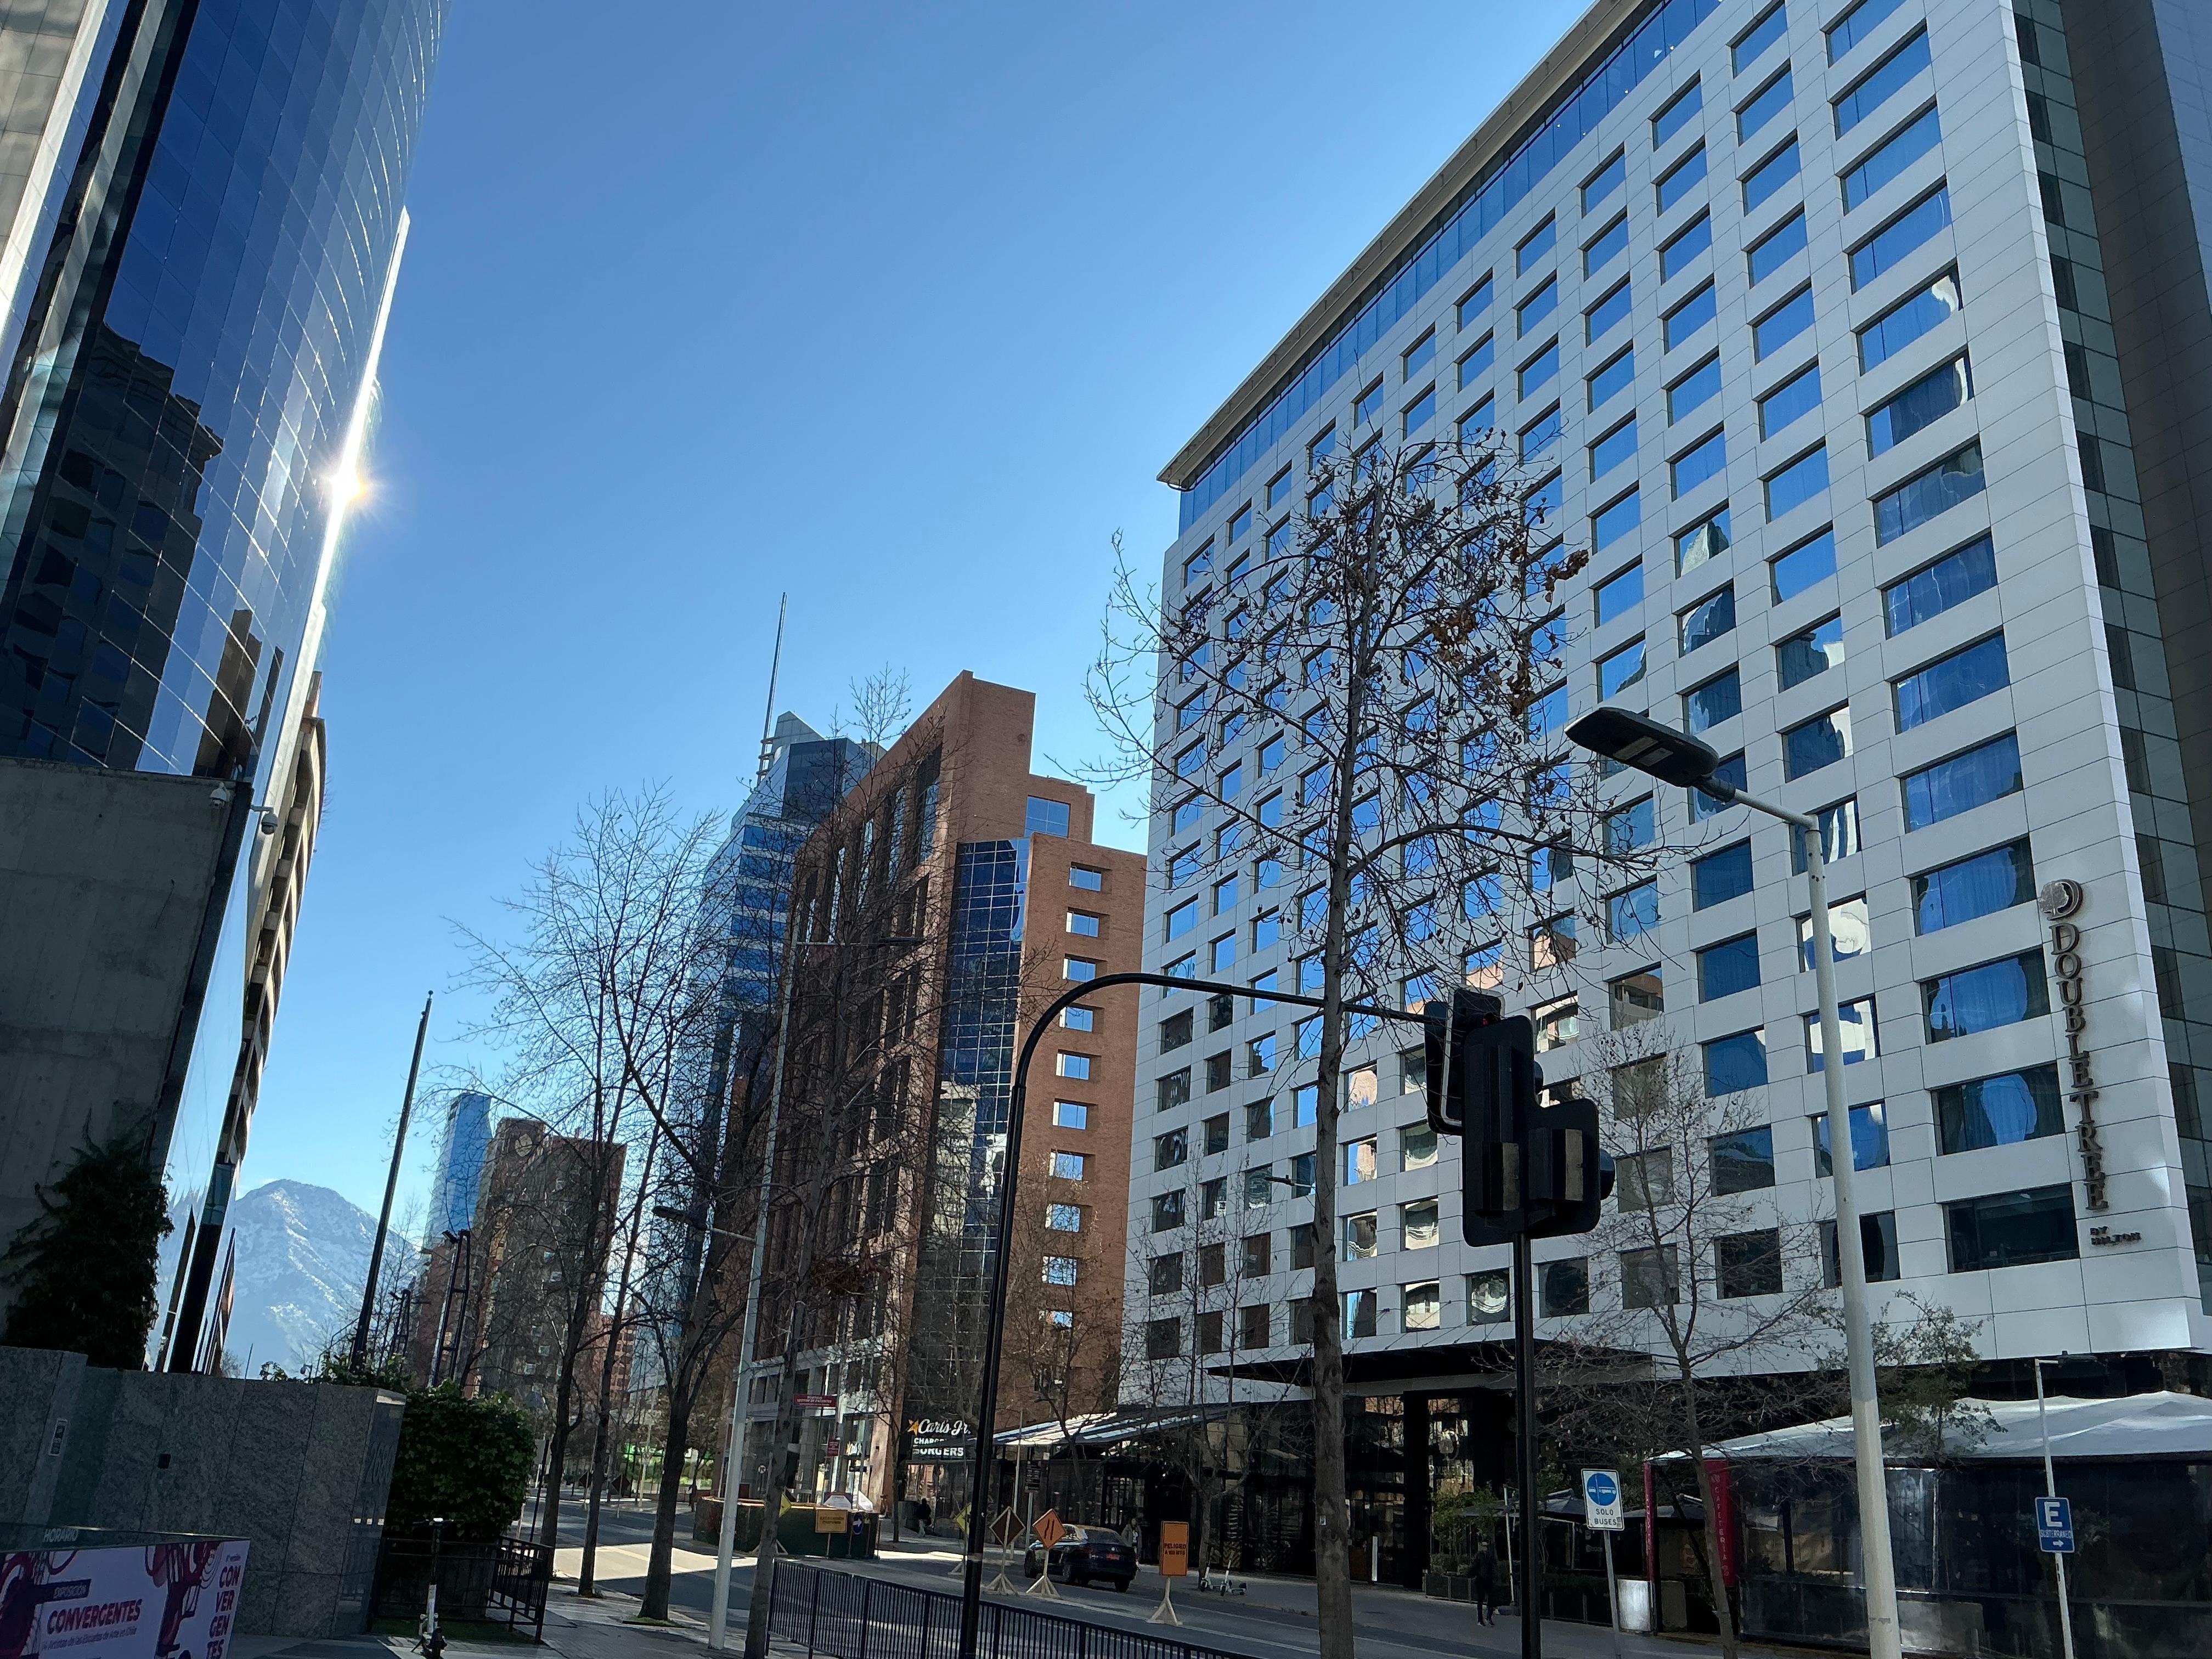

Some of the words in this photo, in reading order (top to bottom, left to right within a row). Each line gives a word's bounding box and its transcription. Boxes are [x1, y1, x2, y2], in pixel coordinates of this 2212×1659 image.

[2049, 922, 2108, 1211] DOUBLETREE
[918, 1419, 951, 1434] Carl's
[951, 1420, 971, 1436] Jr.
[2044, 1502, 2062, 1527] E
[43, 1528, 78, 1542] HORARIO
[219, 1565, 241, 1588] CON
[216, 1590, 235, 1613] VER
[47, 1599, 143, 1634] CONVERGENTES
[210, 1614, 230, 1638] GEN
[206, 1639, 224, 1659] TES
